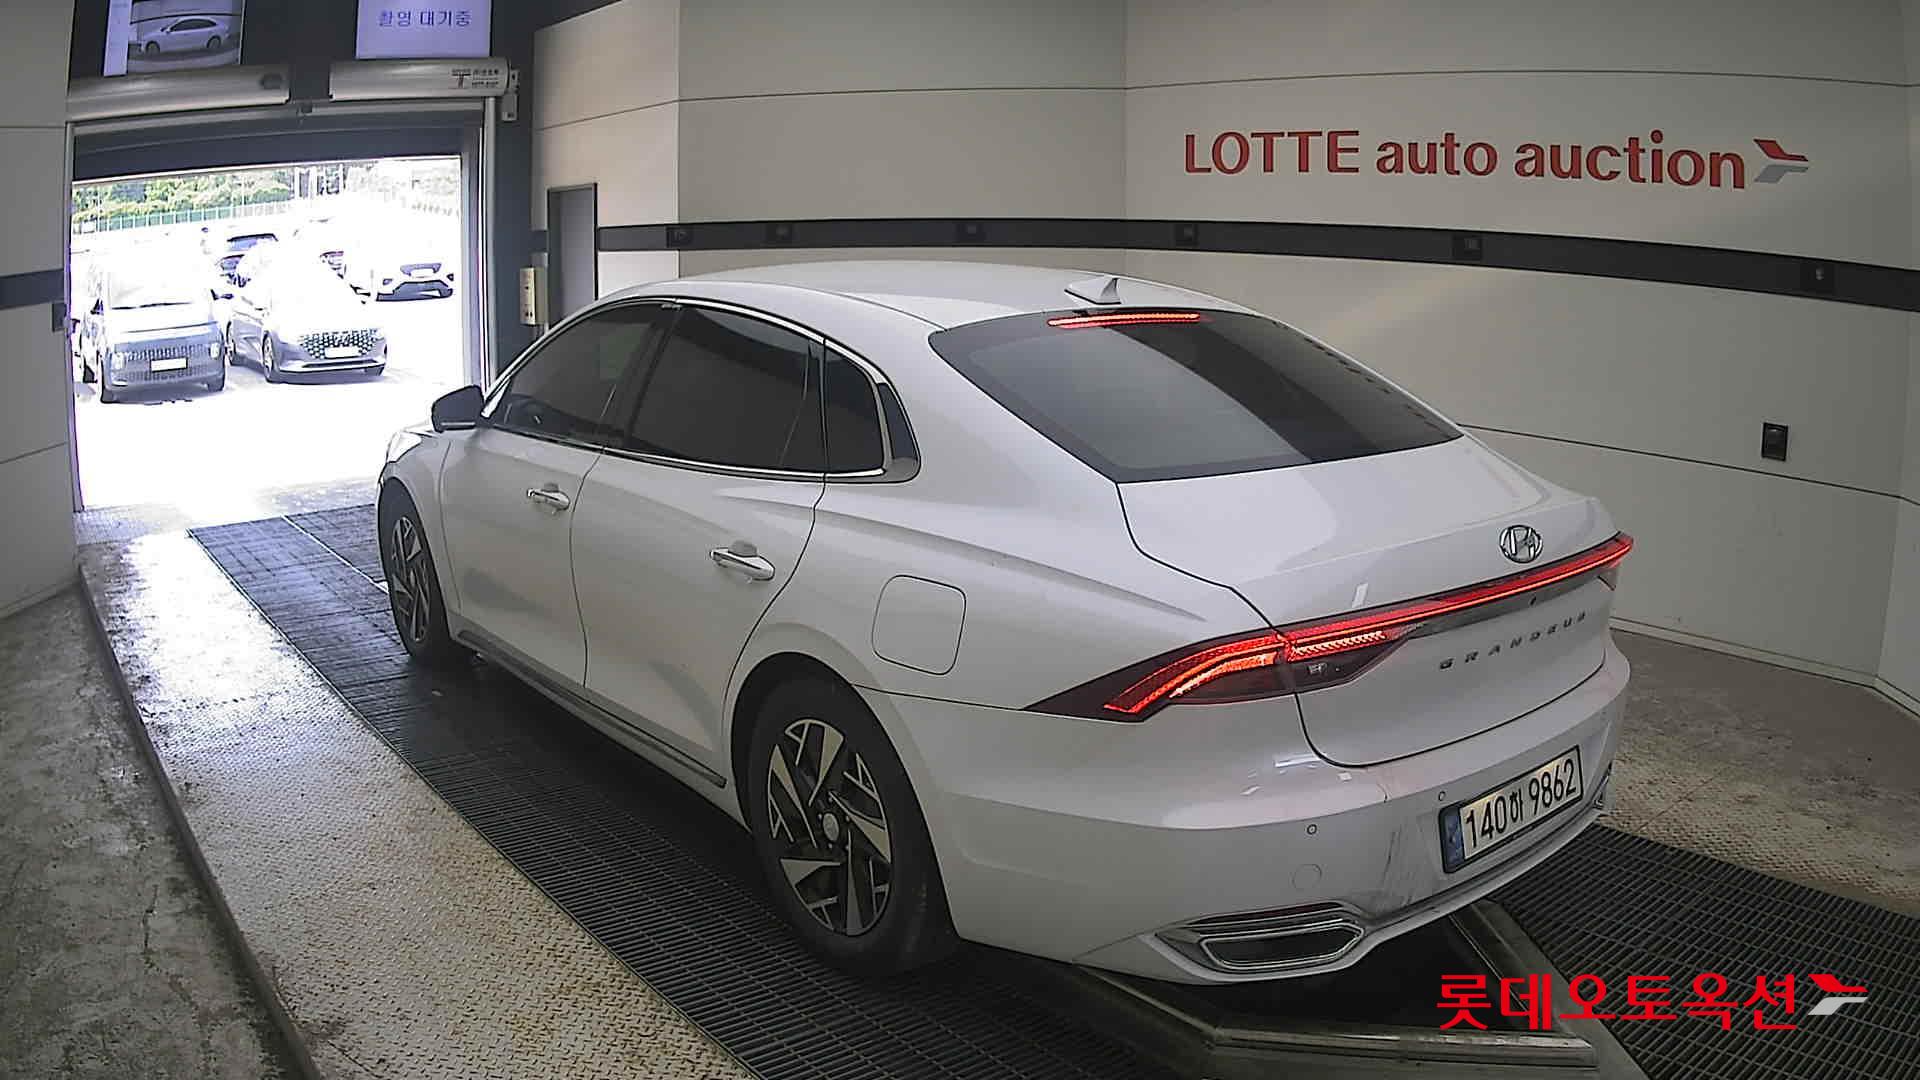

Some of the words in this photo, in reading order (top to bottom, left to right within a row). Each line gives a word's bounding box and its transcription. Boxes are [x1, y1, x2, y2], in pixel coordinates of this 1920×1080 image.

[420, 10, 471, 27] 대기중
[1185, 130, 1360, 174] LOTTE
[1376, 132, 1498, 176] auto
[1514, 129, 1745, 189] auction
[1439, 611, 1586, 670] GRANDEUR
[1528, 758, 1577, 816] 9862
